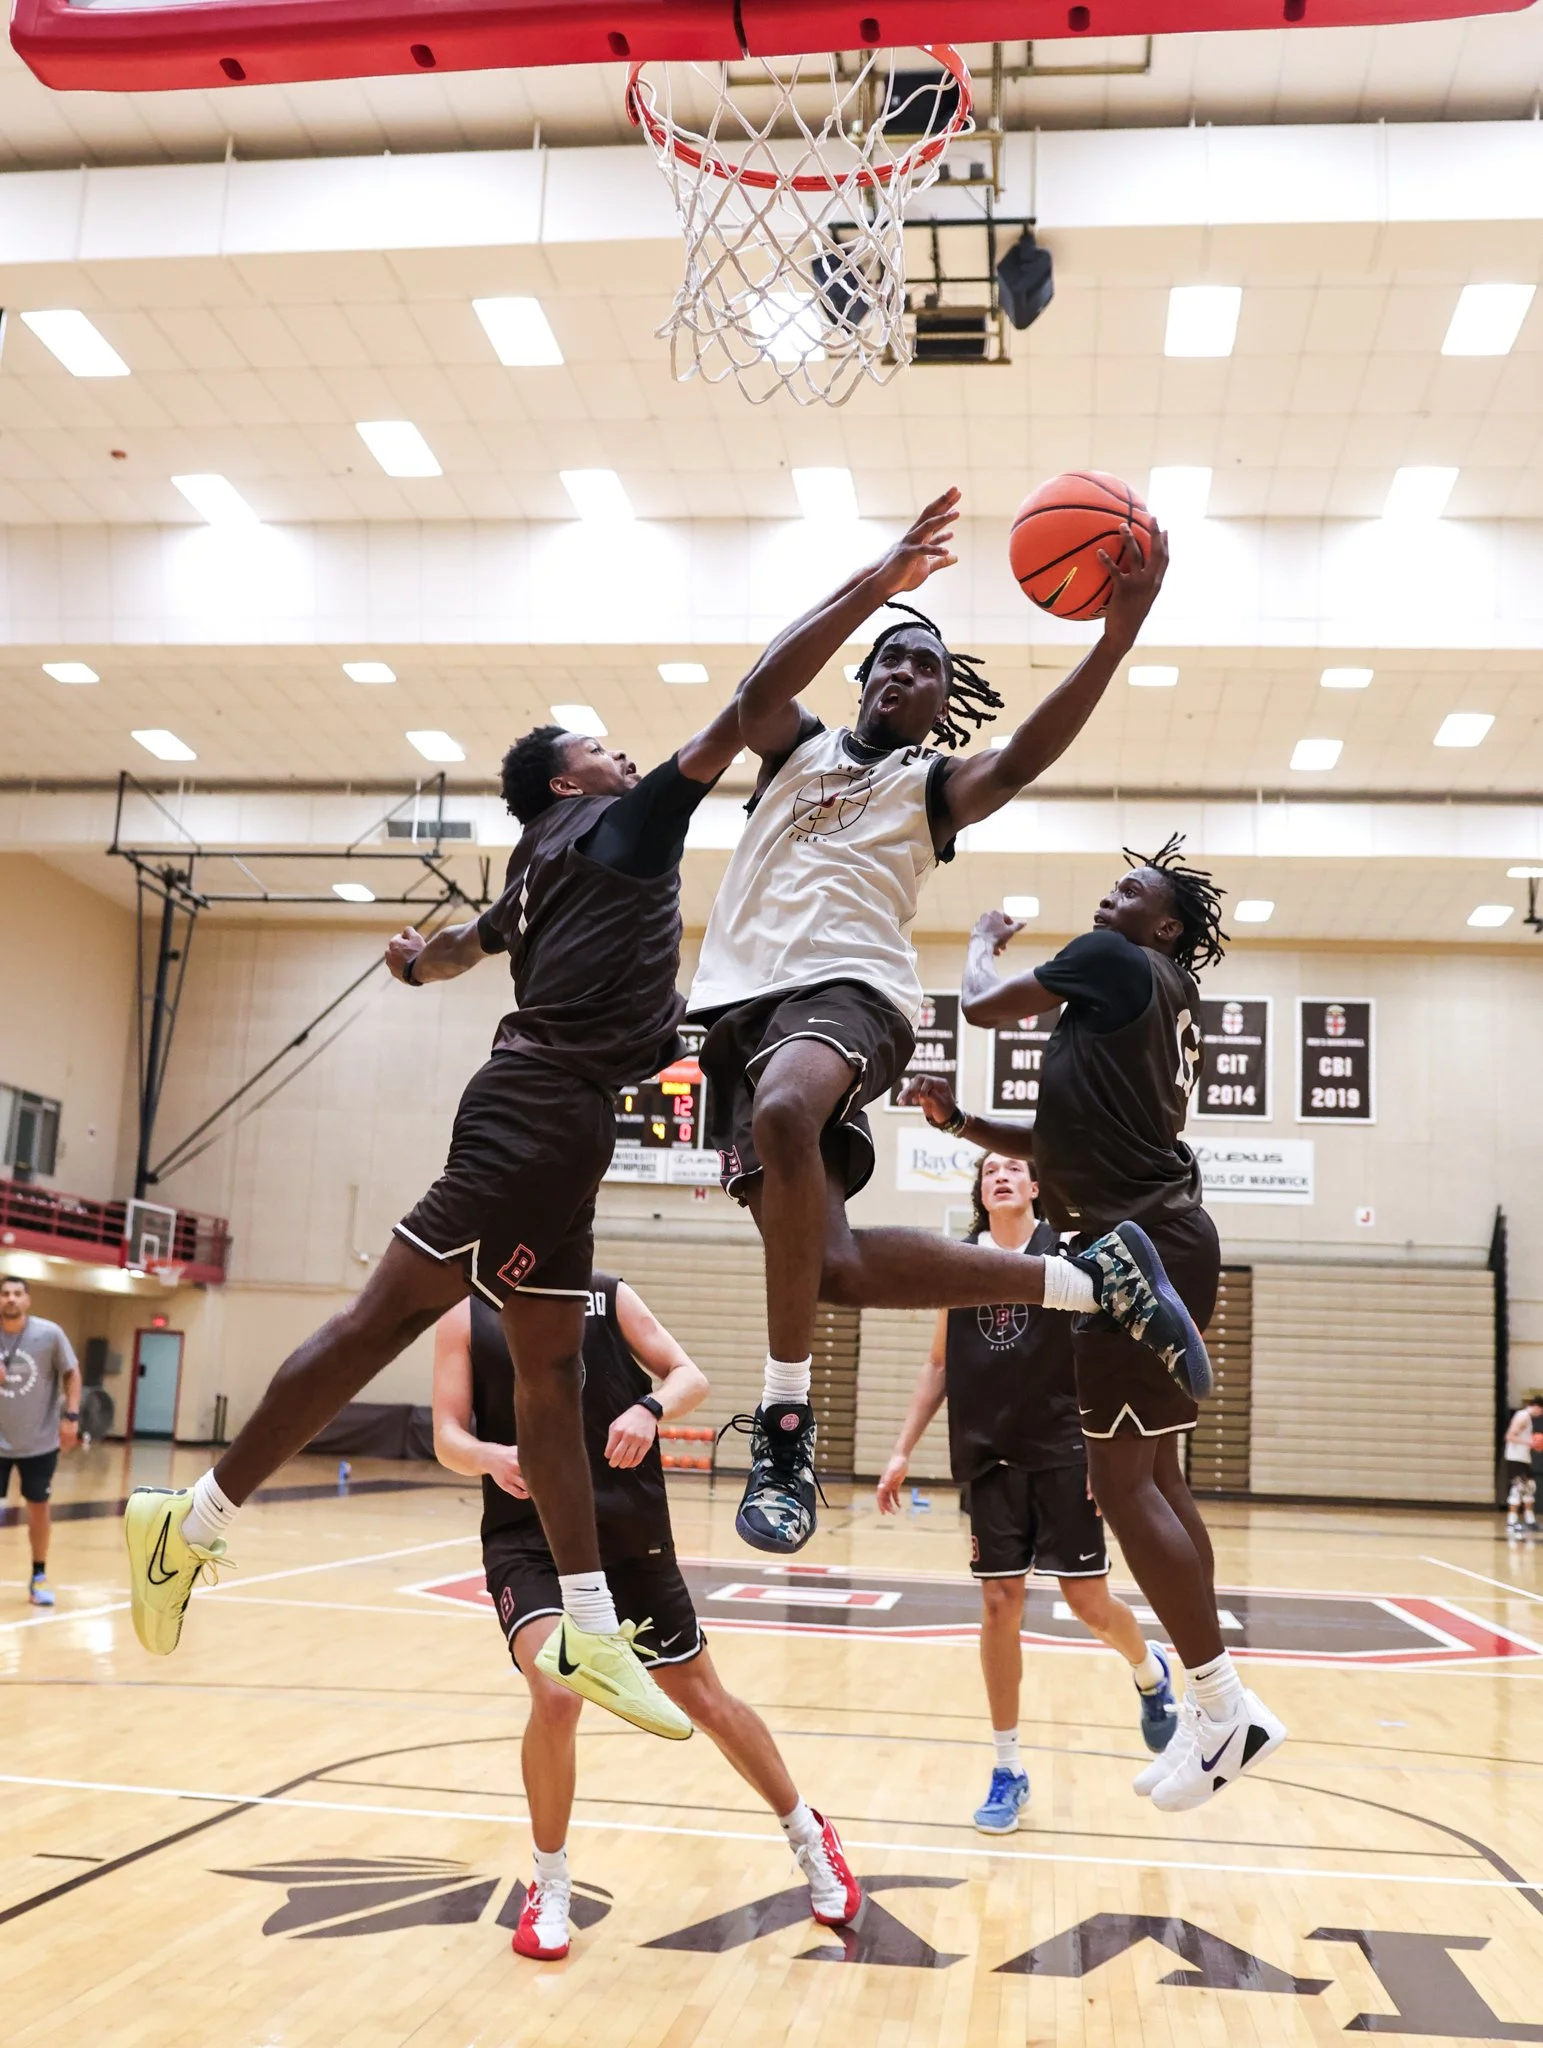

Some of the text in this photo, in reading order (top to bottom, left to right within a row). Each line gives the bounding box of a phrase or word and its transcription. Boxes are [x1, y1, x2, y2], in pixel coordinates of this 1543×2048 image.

[914, 1042, 945, 1060] CAA
[1011, 1049, 1043, 1070] NIT
[1216, 1053, 1249, 1075] CIT
[1318, 1056, 1353, 1078] CBI
[1001, 1079, 1040, 1101] 200
[1206, 1084, 1256, 1106] 2014
[1310, 1087, 1361, 1109] 2019
[673, 1094, 694, 1117] 12
[678, 1122, 692, 1142] 0
[1214, 1152, 1283, 1164] LEXUS
[1203, 1173, 1226, 1185] XUS
[1249, 1175, 1310, 1187] WARWICK
[496, 1243, 536, 1288] B
[996, 1308, 1010, 1327] B
